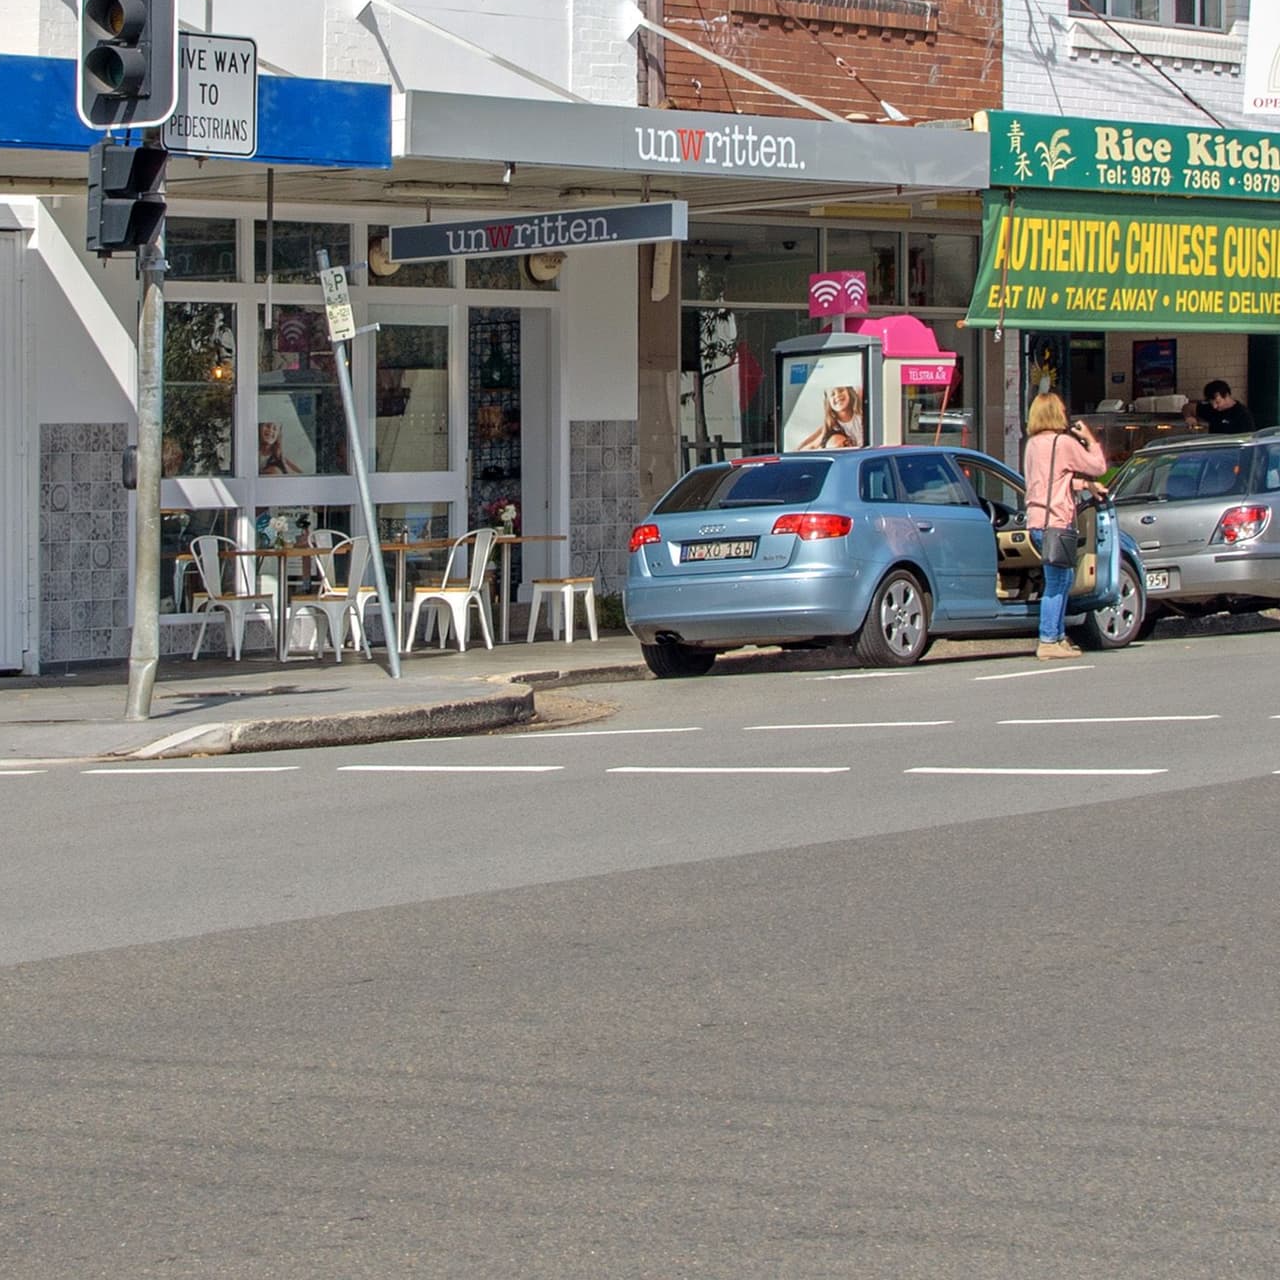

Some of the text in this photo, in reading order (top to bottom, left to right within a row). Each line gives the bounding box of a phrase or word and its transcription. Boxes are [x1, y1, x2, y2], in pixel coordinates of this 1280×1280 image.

[180, 47, 251, 75] IVE WAY
[199, 82, 219, 106] TO
[170, 114, 248, 142] PEDESTRIANS
[635, 124, 806, 170] unwritten.
[1007, 120, 1033, 182] 青禾
[1094, 125, 1173, 164] Rice
[1095, 164, 1127, 185] Tel:
[1131, 165, 1171, 187] 9879
[1182, 168, 1221, 190] 7366
[1243, 172, 1280, 194] 9879
[446, 215, 618, 254] unwritten.
[993, 216, 1121, 275] AUTHENTIC
[1125, 221, 1218, 276] CHINESE
[333, 273, 344, 291] P
[987, 284, 1023, 309] EAT
[1026, 285, 1047, 310] IN
[1065, 286, 1108, 311] TAKE
[1110, 287, 1158, 312] AWAY
[1175, 289, 1224, 313] HOME
[908, 370, 933, 381] TELSTRA
